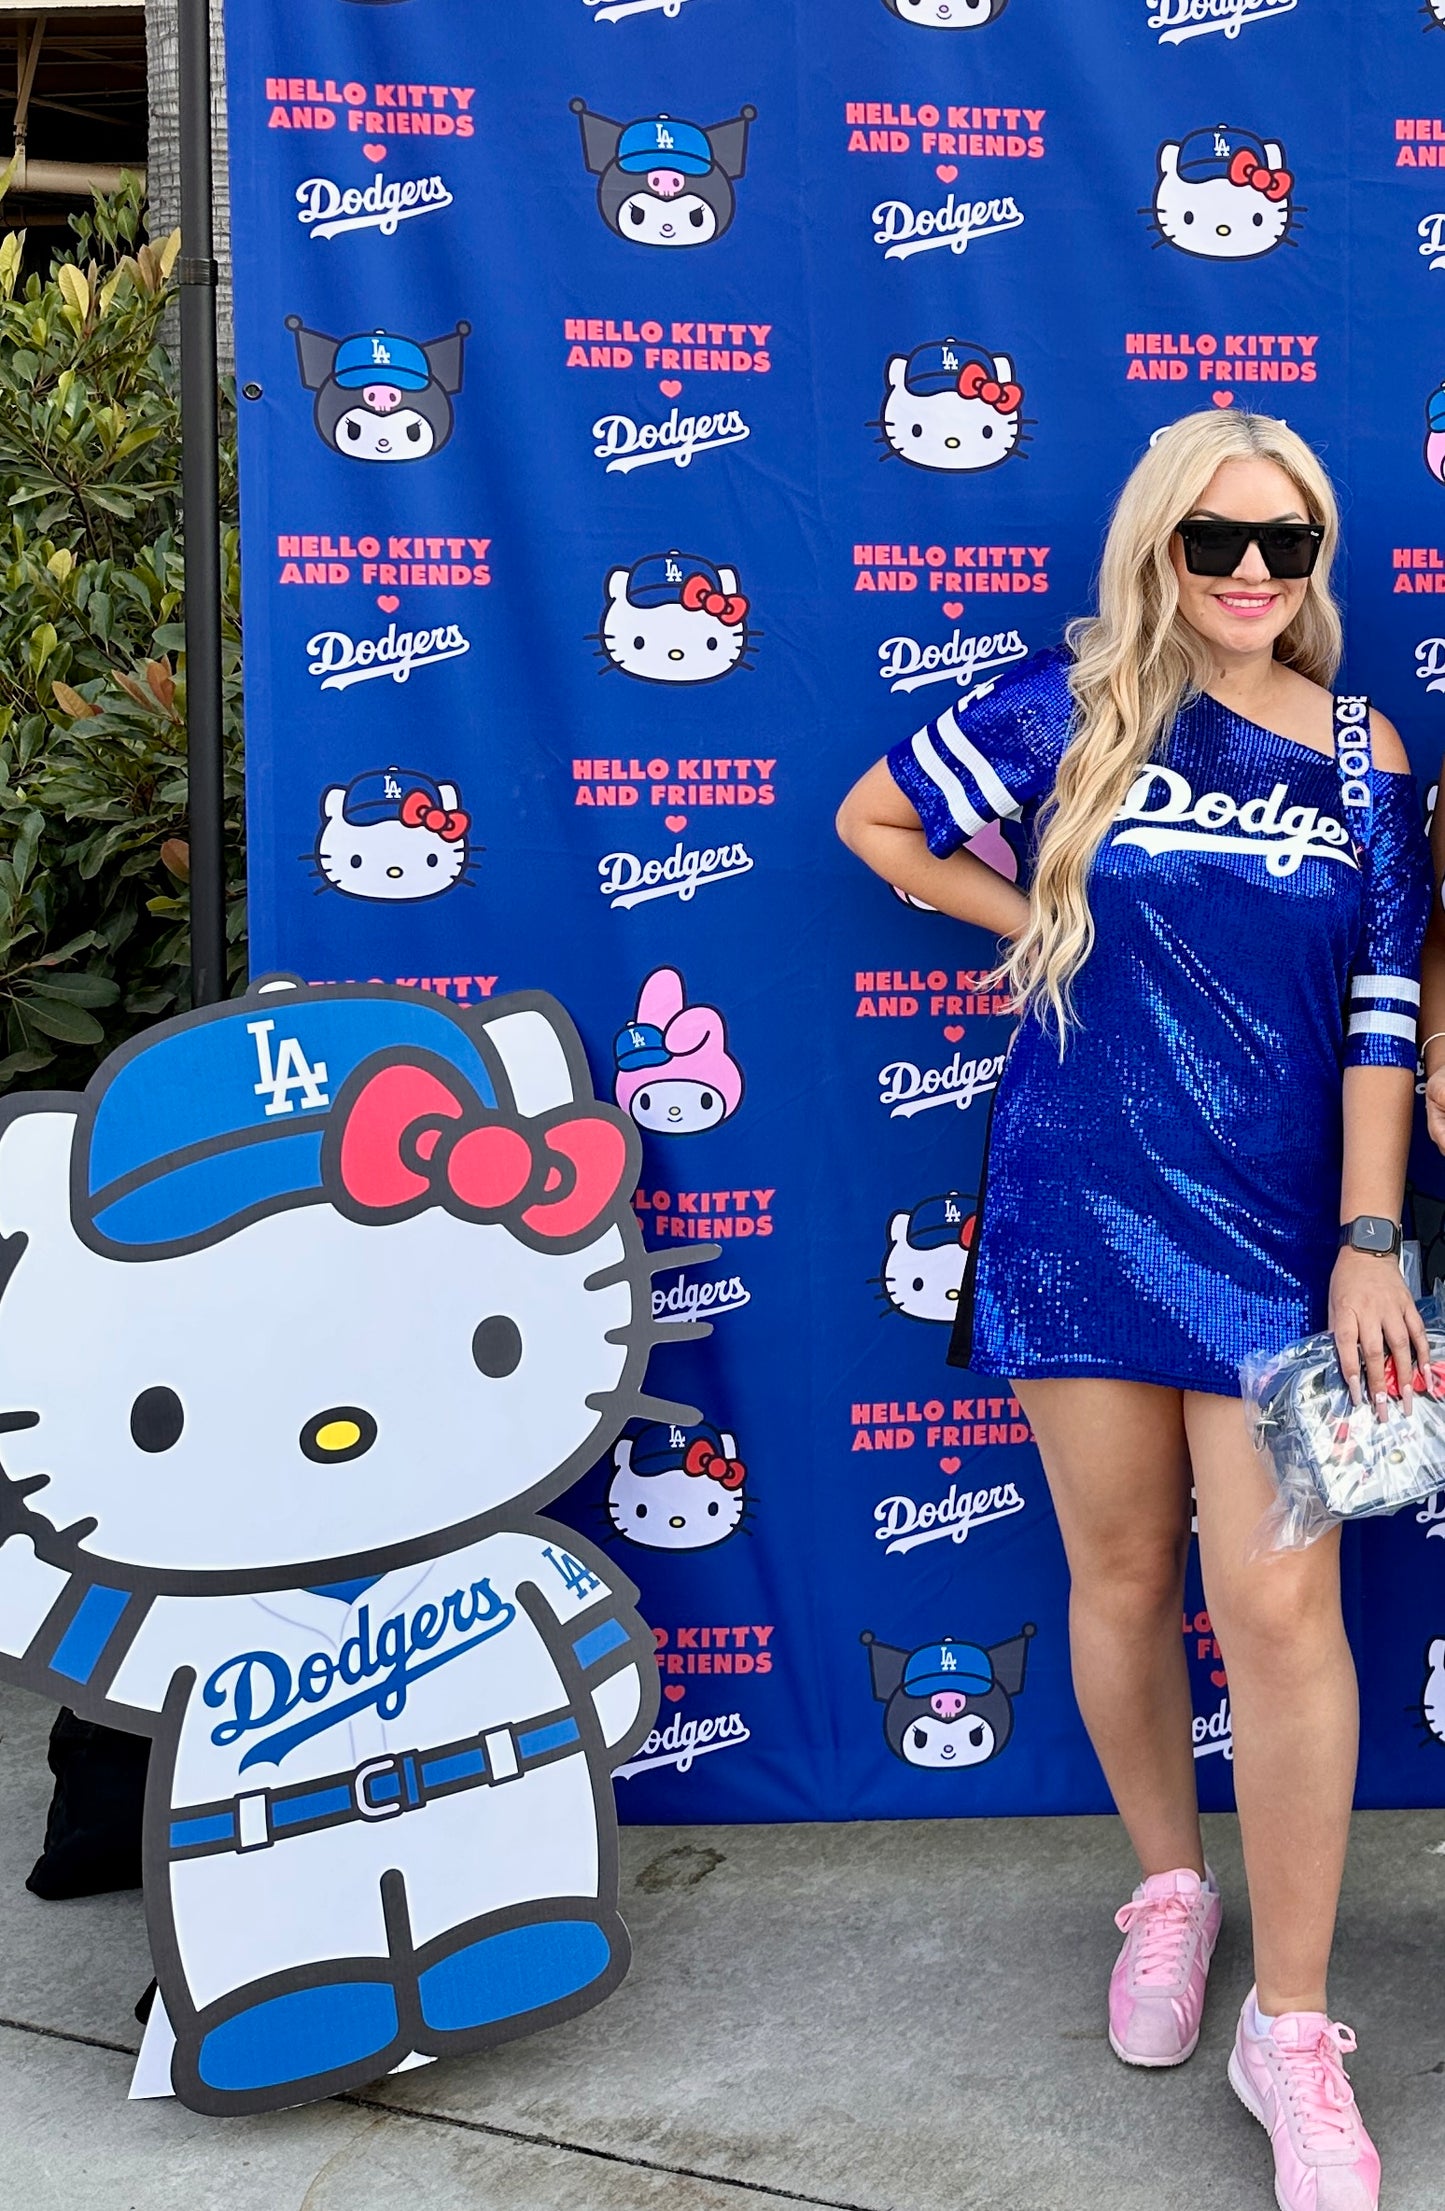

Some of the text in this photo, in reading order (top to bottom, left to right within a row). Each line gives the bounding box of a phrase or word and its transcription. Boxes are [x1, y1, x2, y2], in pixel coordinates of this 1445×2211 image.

[266, 78, 475, 109] HELLO KITTY
[268, 107, 474, 137] AND FRIENDS
[846, 103, 1046, 131] HELLO KITTY
[656, 124, 673, 148] LA
[1396, 120, 1445, 140] HEL
[848, 131, 1044, 158] AND FRIENDS
[1214, 133, 1229, 156] LA
[296, 174, 453, 239] Dodgers
[872, 194, 1024, 260] Dodgers
[565, 319, 771, 346] HELLO KITTY
[372, 340, 390, 363] LA
[1126, 334, 1319, 356] HELLO KITTY
[567, 346, 771, 373] AND FRIENDS
[942, 347, 958, 369] LA
[1126, 360, 1317, 382] AND FRIENDS
[593, 408, 749, 473] Dodgers
[278, 536, 491, 560] HELLO KITTY
[853, 545, 1050, 567] HELLO KITTY
[1392, 549, 1445, 568] HEL
[280, 563, 491, 585] AND FRIENDS
[666, 559, 682, 581] LA
[855, 571, 1049, 593] AND FRIENDS
[307, 624, 469, 690] Dodgers
[879, 629, 1028, 693] Dodgers
[572, 759, 776, 780] HELLO KITTY
[384, 776, 401, 798] LA
[575, 784, 775, 806] AND FRIENDS
[1104, 763, 1360, 877] Dodge
[599, 843, 753, 909] Dodgers
[856, 971, 948, 992] HELLO
[856, 996, 1022, 1017] AND FRIEN
[629, 1029, 645, 1047] LA
[247, 1020, 329, 1115] LA
[878, 1051, 1006, 1119] Dodger
[678, 1190, 776, 1213] KITTY
[945, 1200, 960, 1222] LA
[656, 1215, 773, 1239] FRIENDS
[651, 1274, 751, 1322] odgers
[851, 1398, 1022, 1424] HELLO KITT
[669, 1425, 686, 1448] LA
[852, 1428, 915, 1450] AND
[874, 1483, 1024, 1554] Dodgers
[542, 1546, 600, 1599] LA
[677, 1626, 774, 1648] KITTY
[941, 1648, 956, 1670] LA
[203, 1577, 516, 1775] Dodgers
[610, 1712, 750, 1780] odgers
